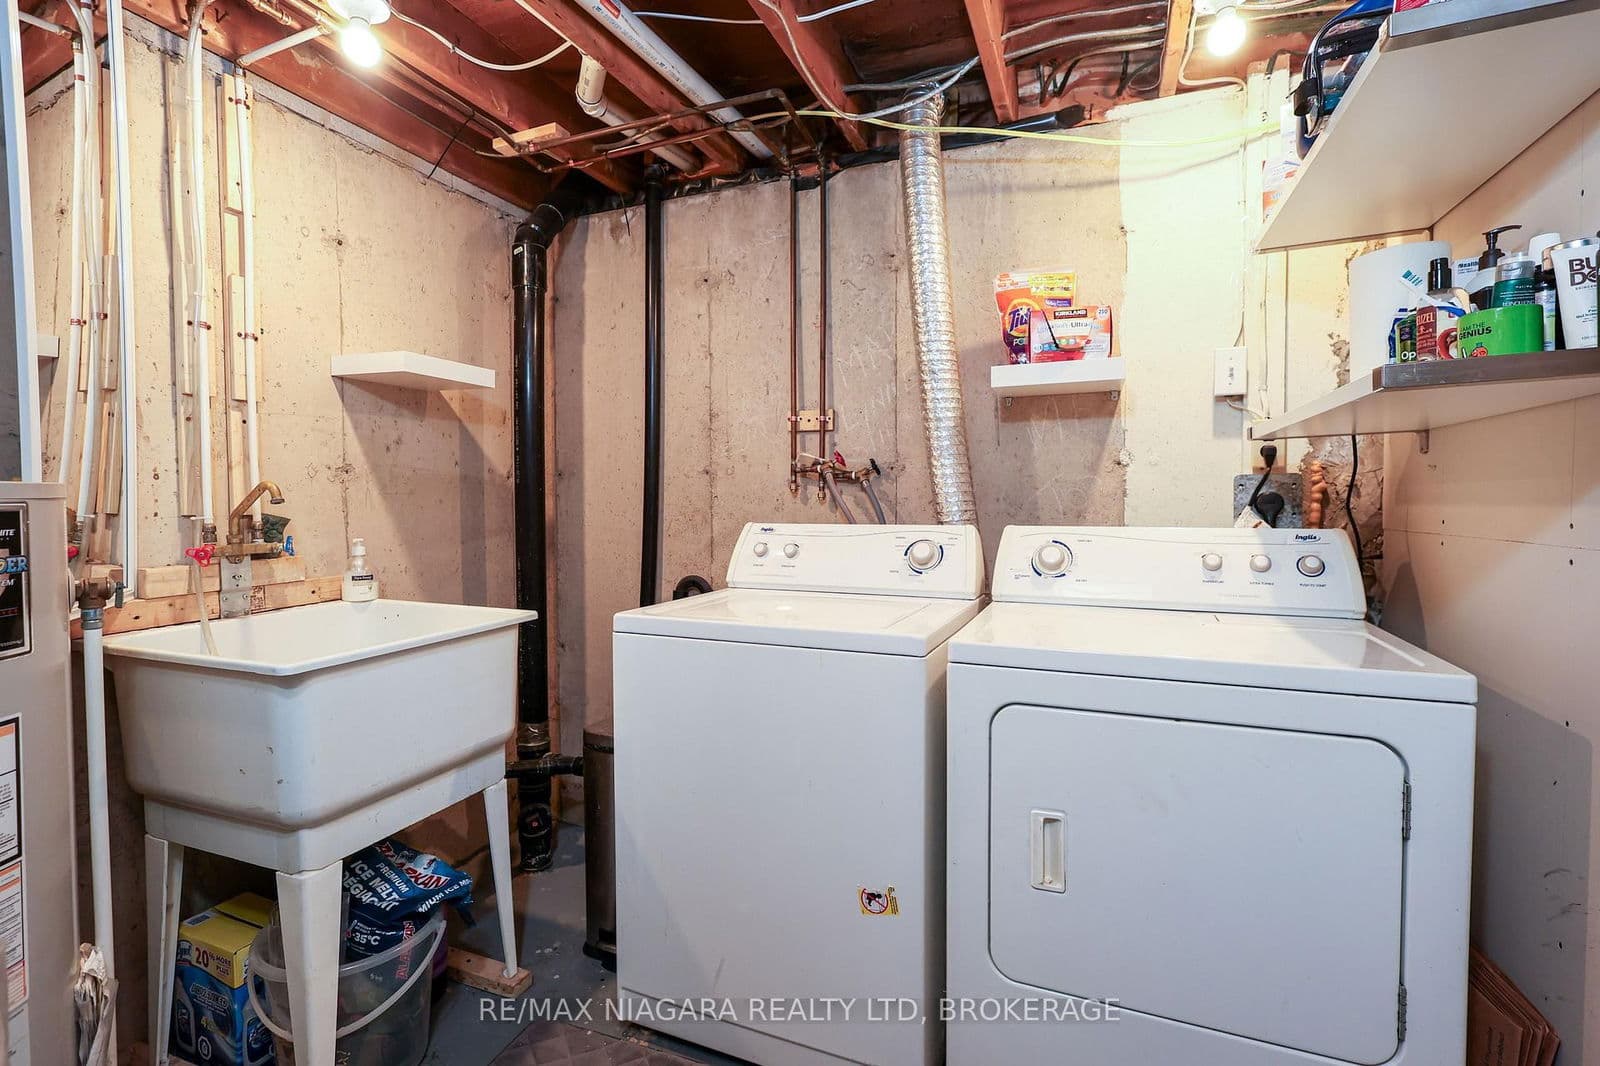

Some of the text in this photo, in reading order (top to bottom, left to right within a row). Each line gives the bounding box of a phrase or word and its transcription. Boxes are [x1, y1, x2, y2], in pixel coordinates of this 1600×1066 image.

[1458, 326, 1493, 340] GENIUS
[350, 860, 376, 881] ICE
[376, 862, 410, 893] PREMIUM
